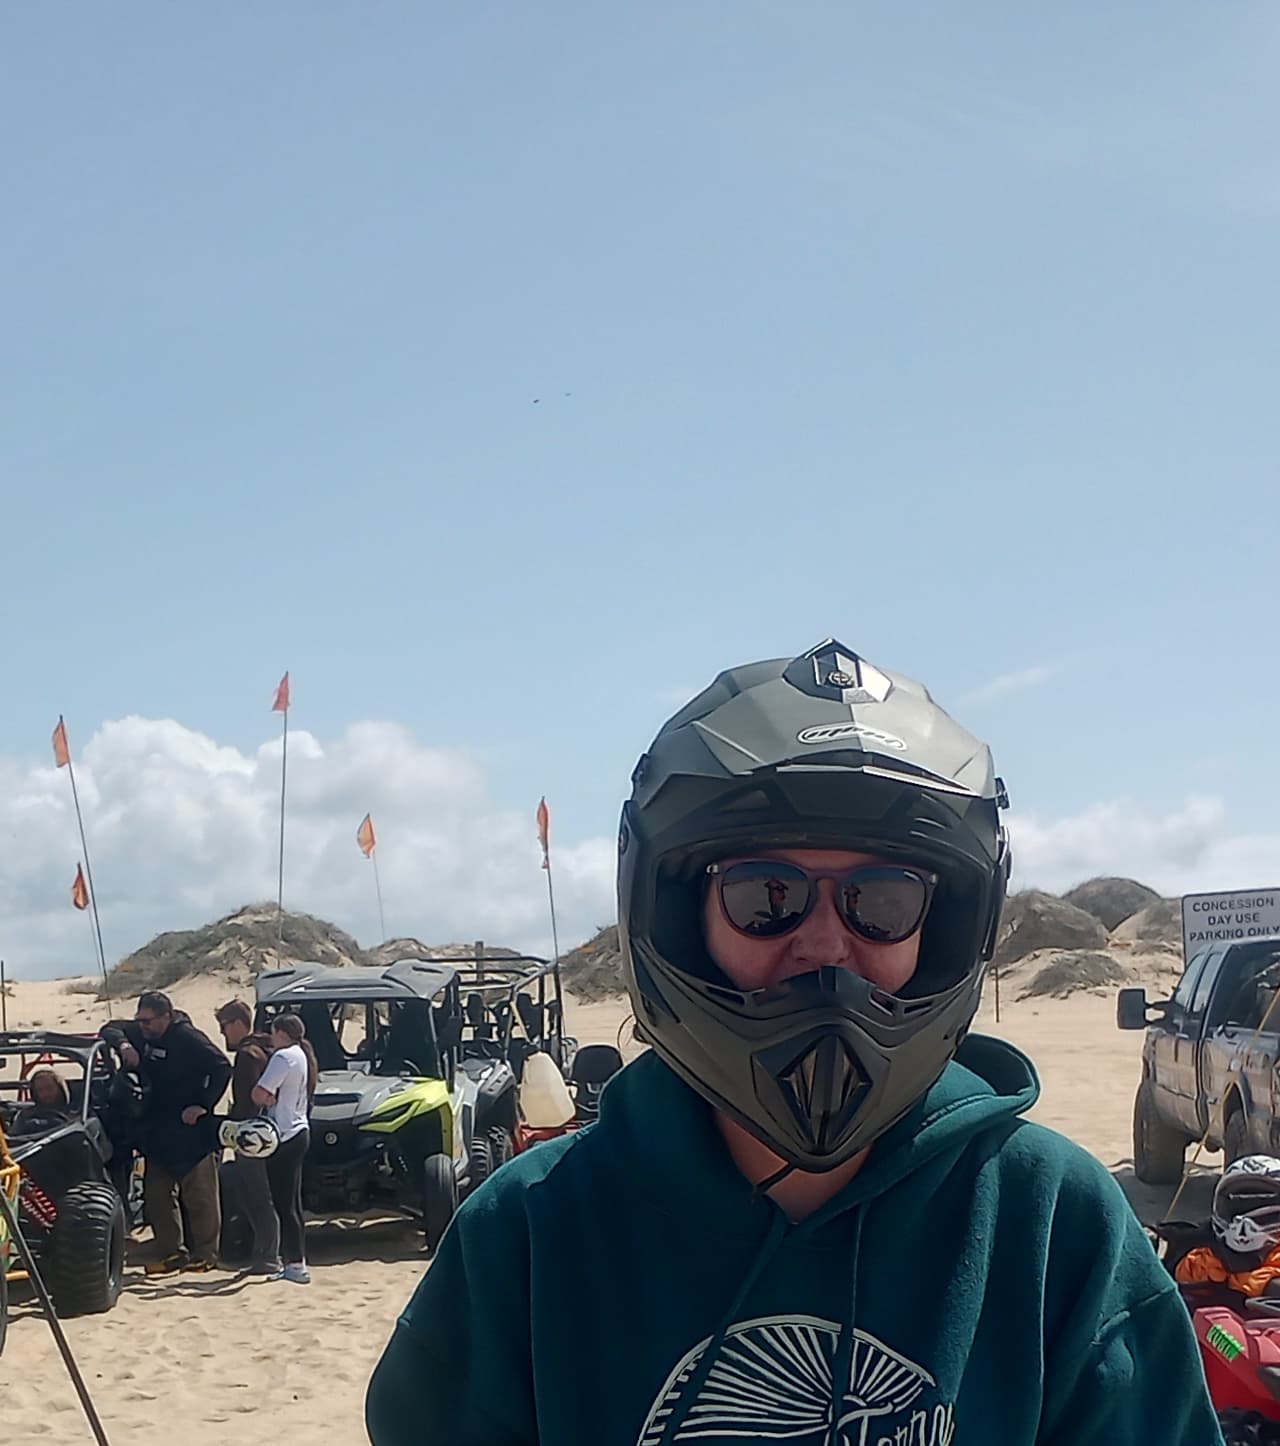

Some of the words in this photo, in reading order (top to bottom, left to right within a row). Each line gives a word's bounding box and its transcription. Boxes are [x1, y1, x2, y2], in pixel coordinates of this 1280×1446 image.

[1193, 897, 1274, 913] CONCESSION
[1208, 915, 1232, 926] DAY
[1235, 913, 1260, 924] USE
[1190, 928, 1244, 941] PARKING
[1248, 926, 1280, 937] ONLY
